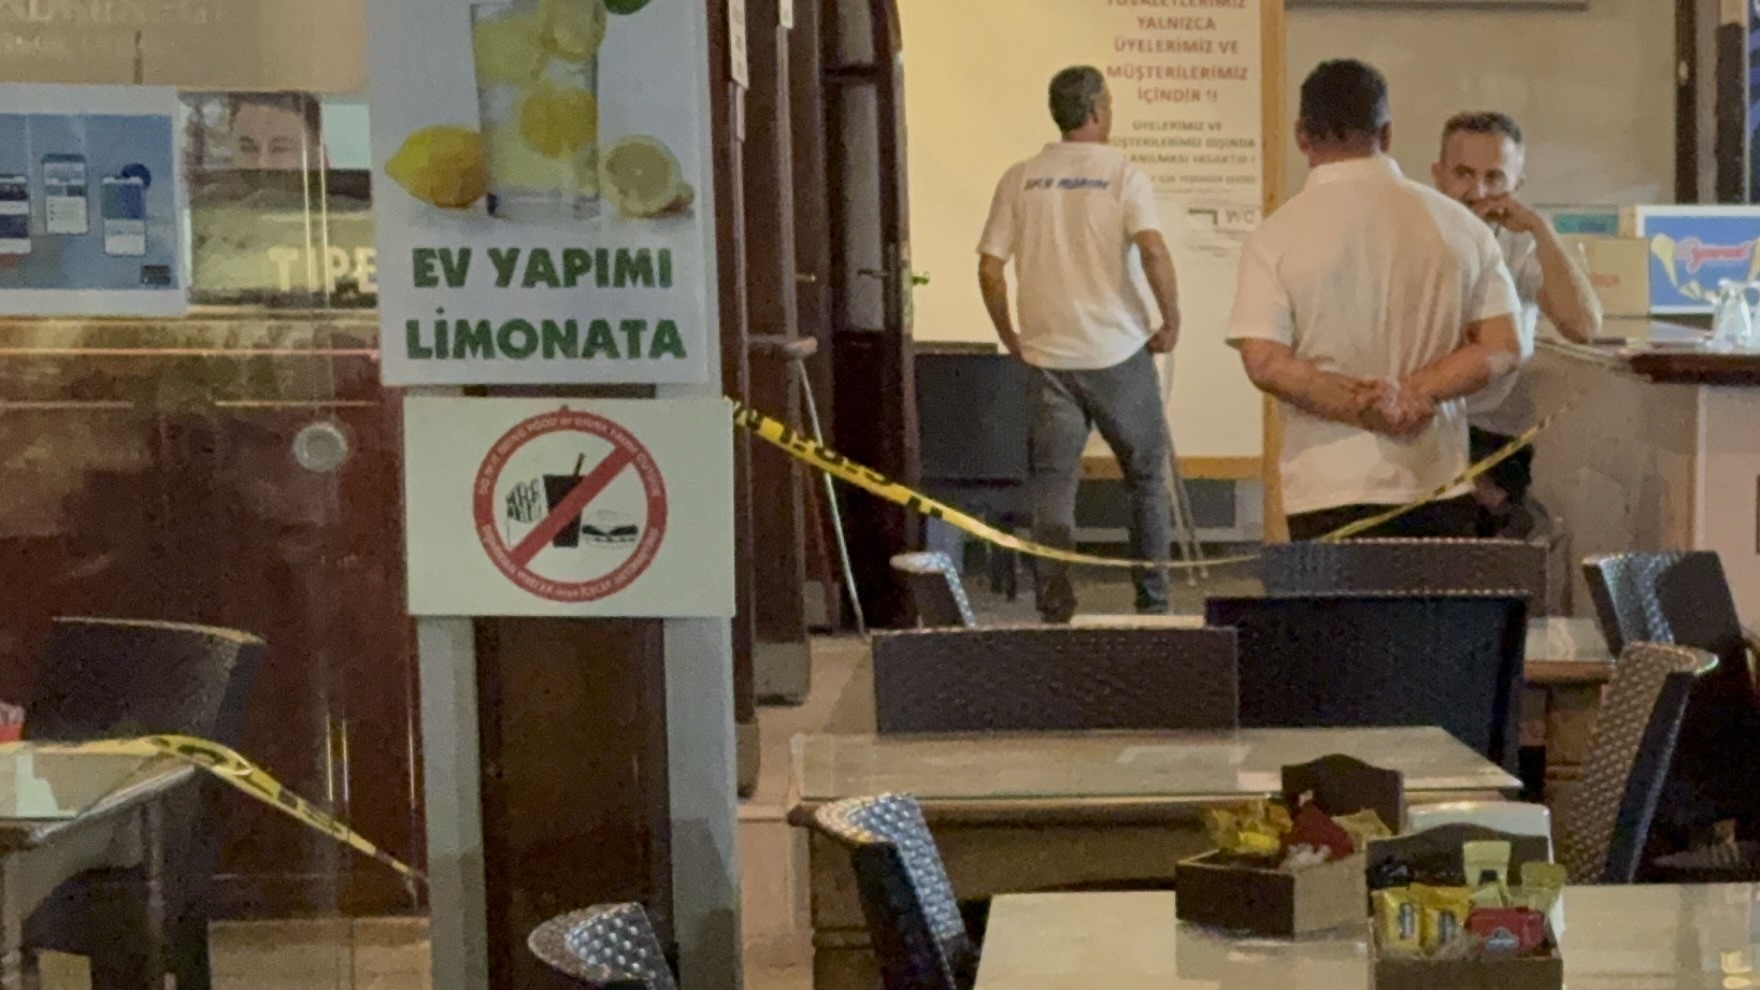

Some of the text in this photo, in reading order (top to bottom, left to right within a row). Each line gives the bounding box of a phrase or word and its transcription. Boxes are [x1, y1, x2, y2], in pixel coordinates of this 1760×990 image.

[1137, 15, 1217, 31] YALNIZCA
[1113, 36, 1239, 54] ÜYELERİMİZ VE
[1106, 63, 1249, 81] MÜŞTERİLERİMİZ
[1137, 87, 1201, 104] İÇİNDİR
[1225, 210, 1256, 224] WC
[412, 247, 673, 289] EV YAPIMI
[405, 306, 687, 361] LİMONATA
